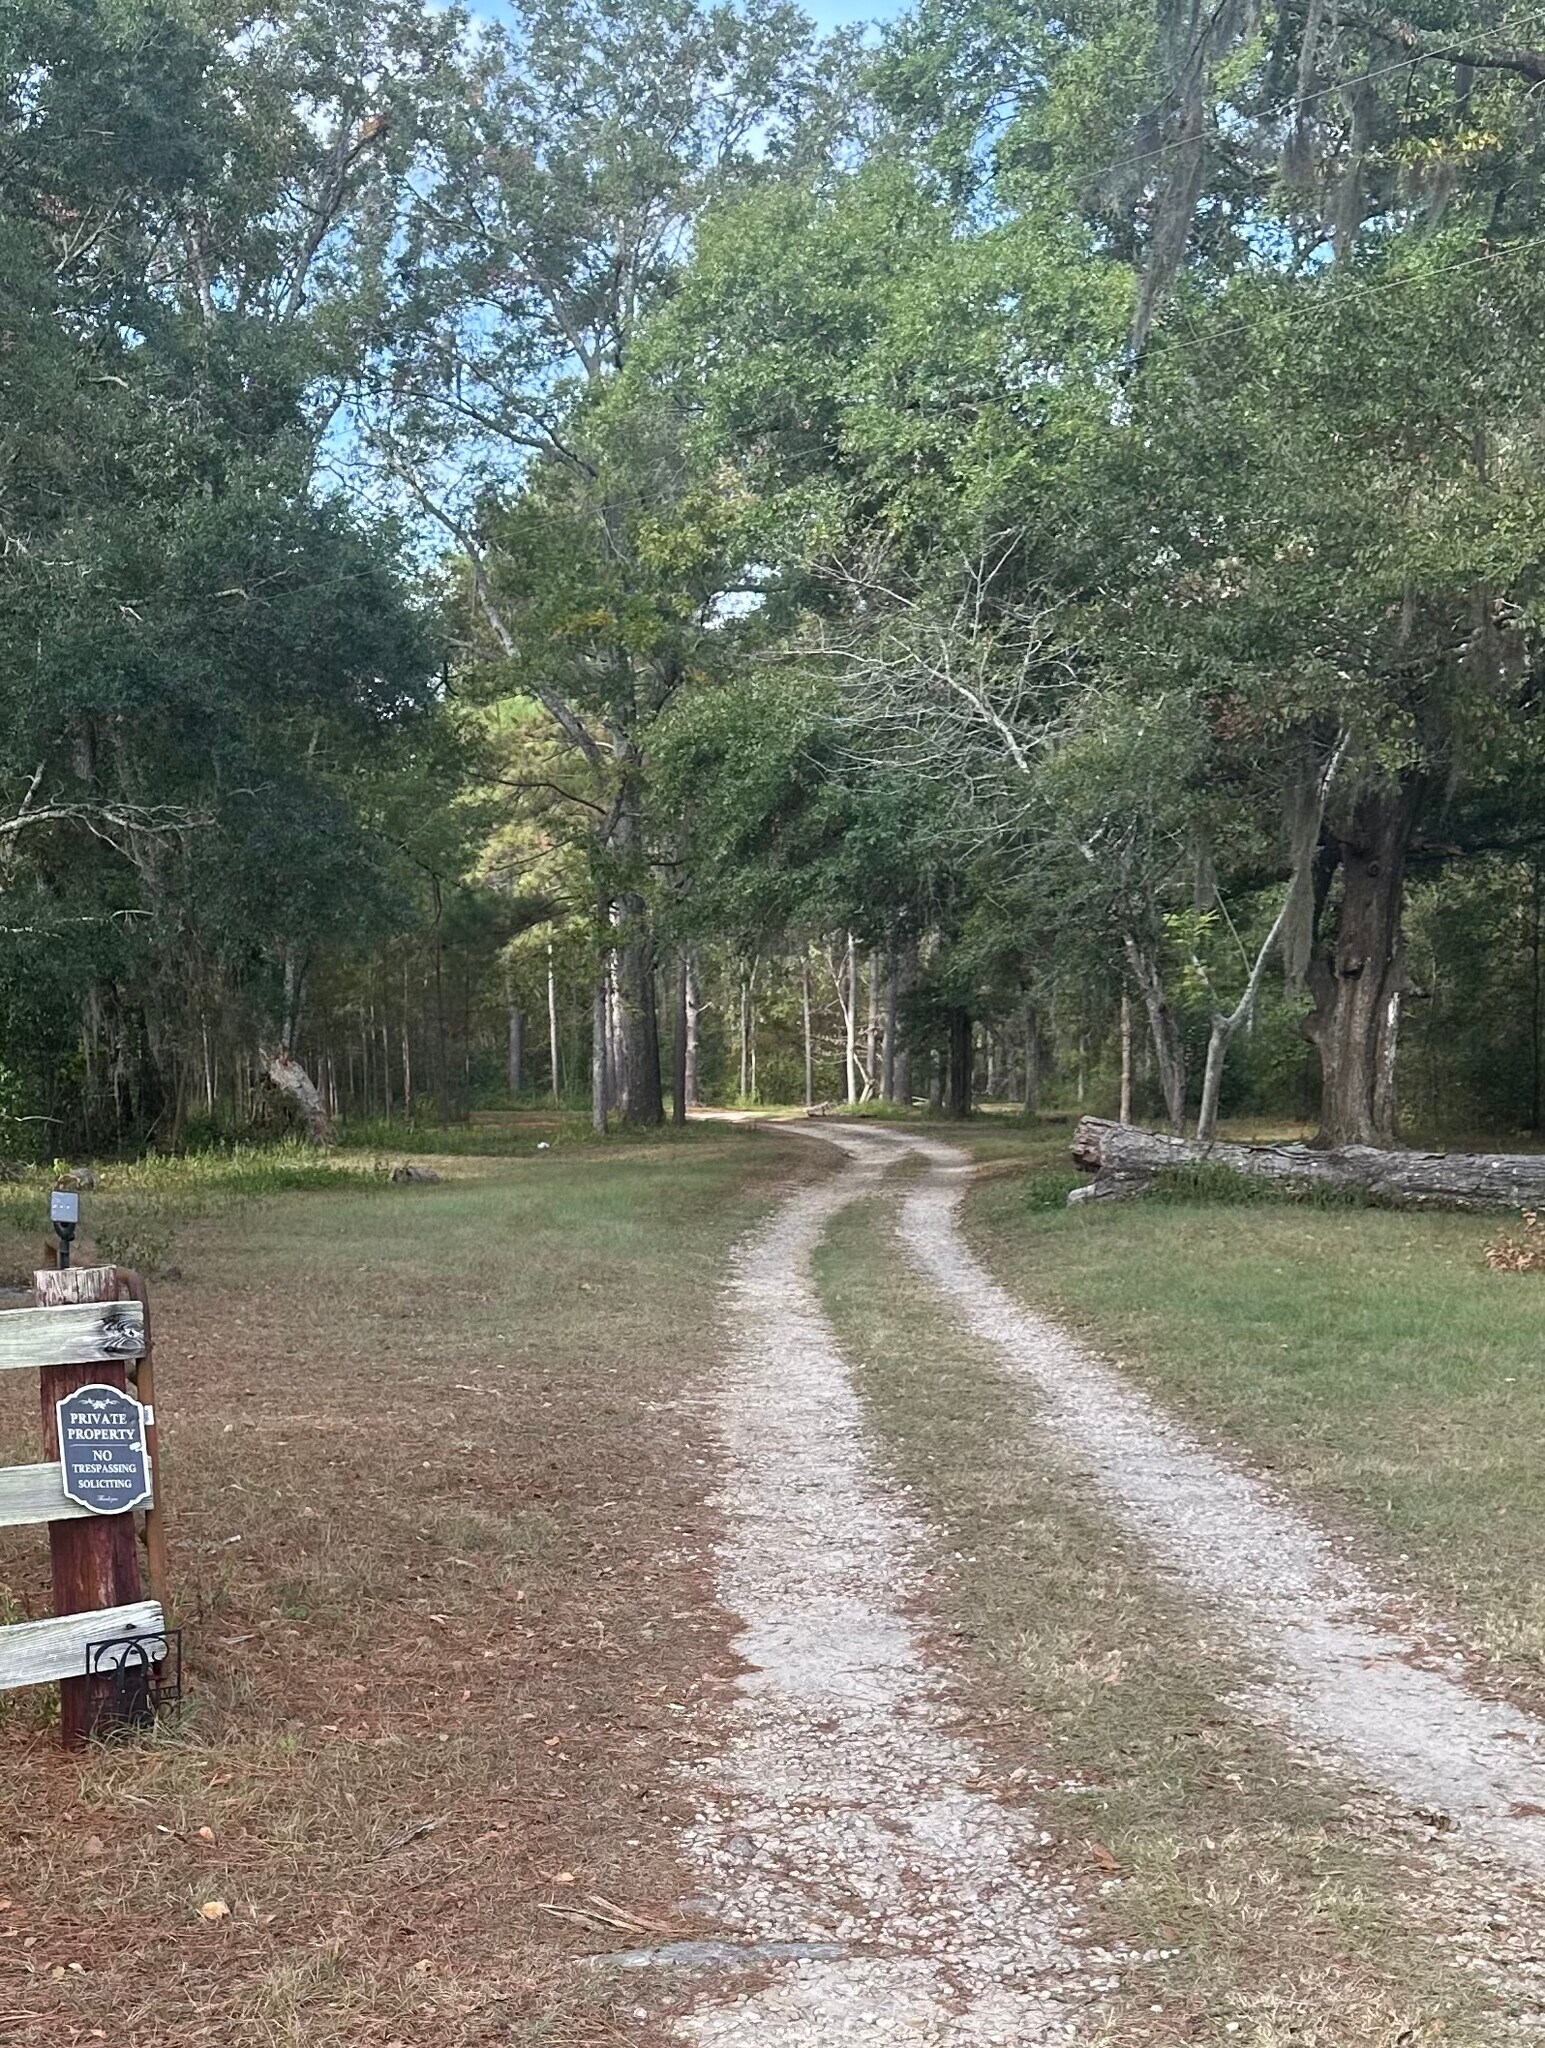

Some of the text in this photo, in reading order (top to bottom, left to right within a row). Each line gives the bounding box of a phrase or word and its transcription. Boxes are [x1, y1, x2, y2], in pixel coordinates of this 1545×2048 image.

[70, 1413, 127, 1424] PRIVATE
[67, 1428, 136, 1440] PROPERTY
[92, 1450, 113, 1461] NO
[72, 1463, 137, 1473] TRESPASSING
[78, 1479, 132, 1489] SOLICITING
